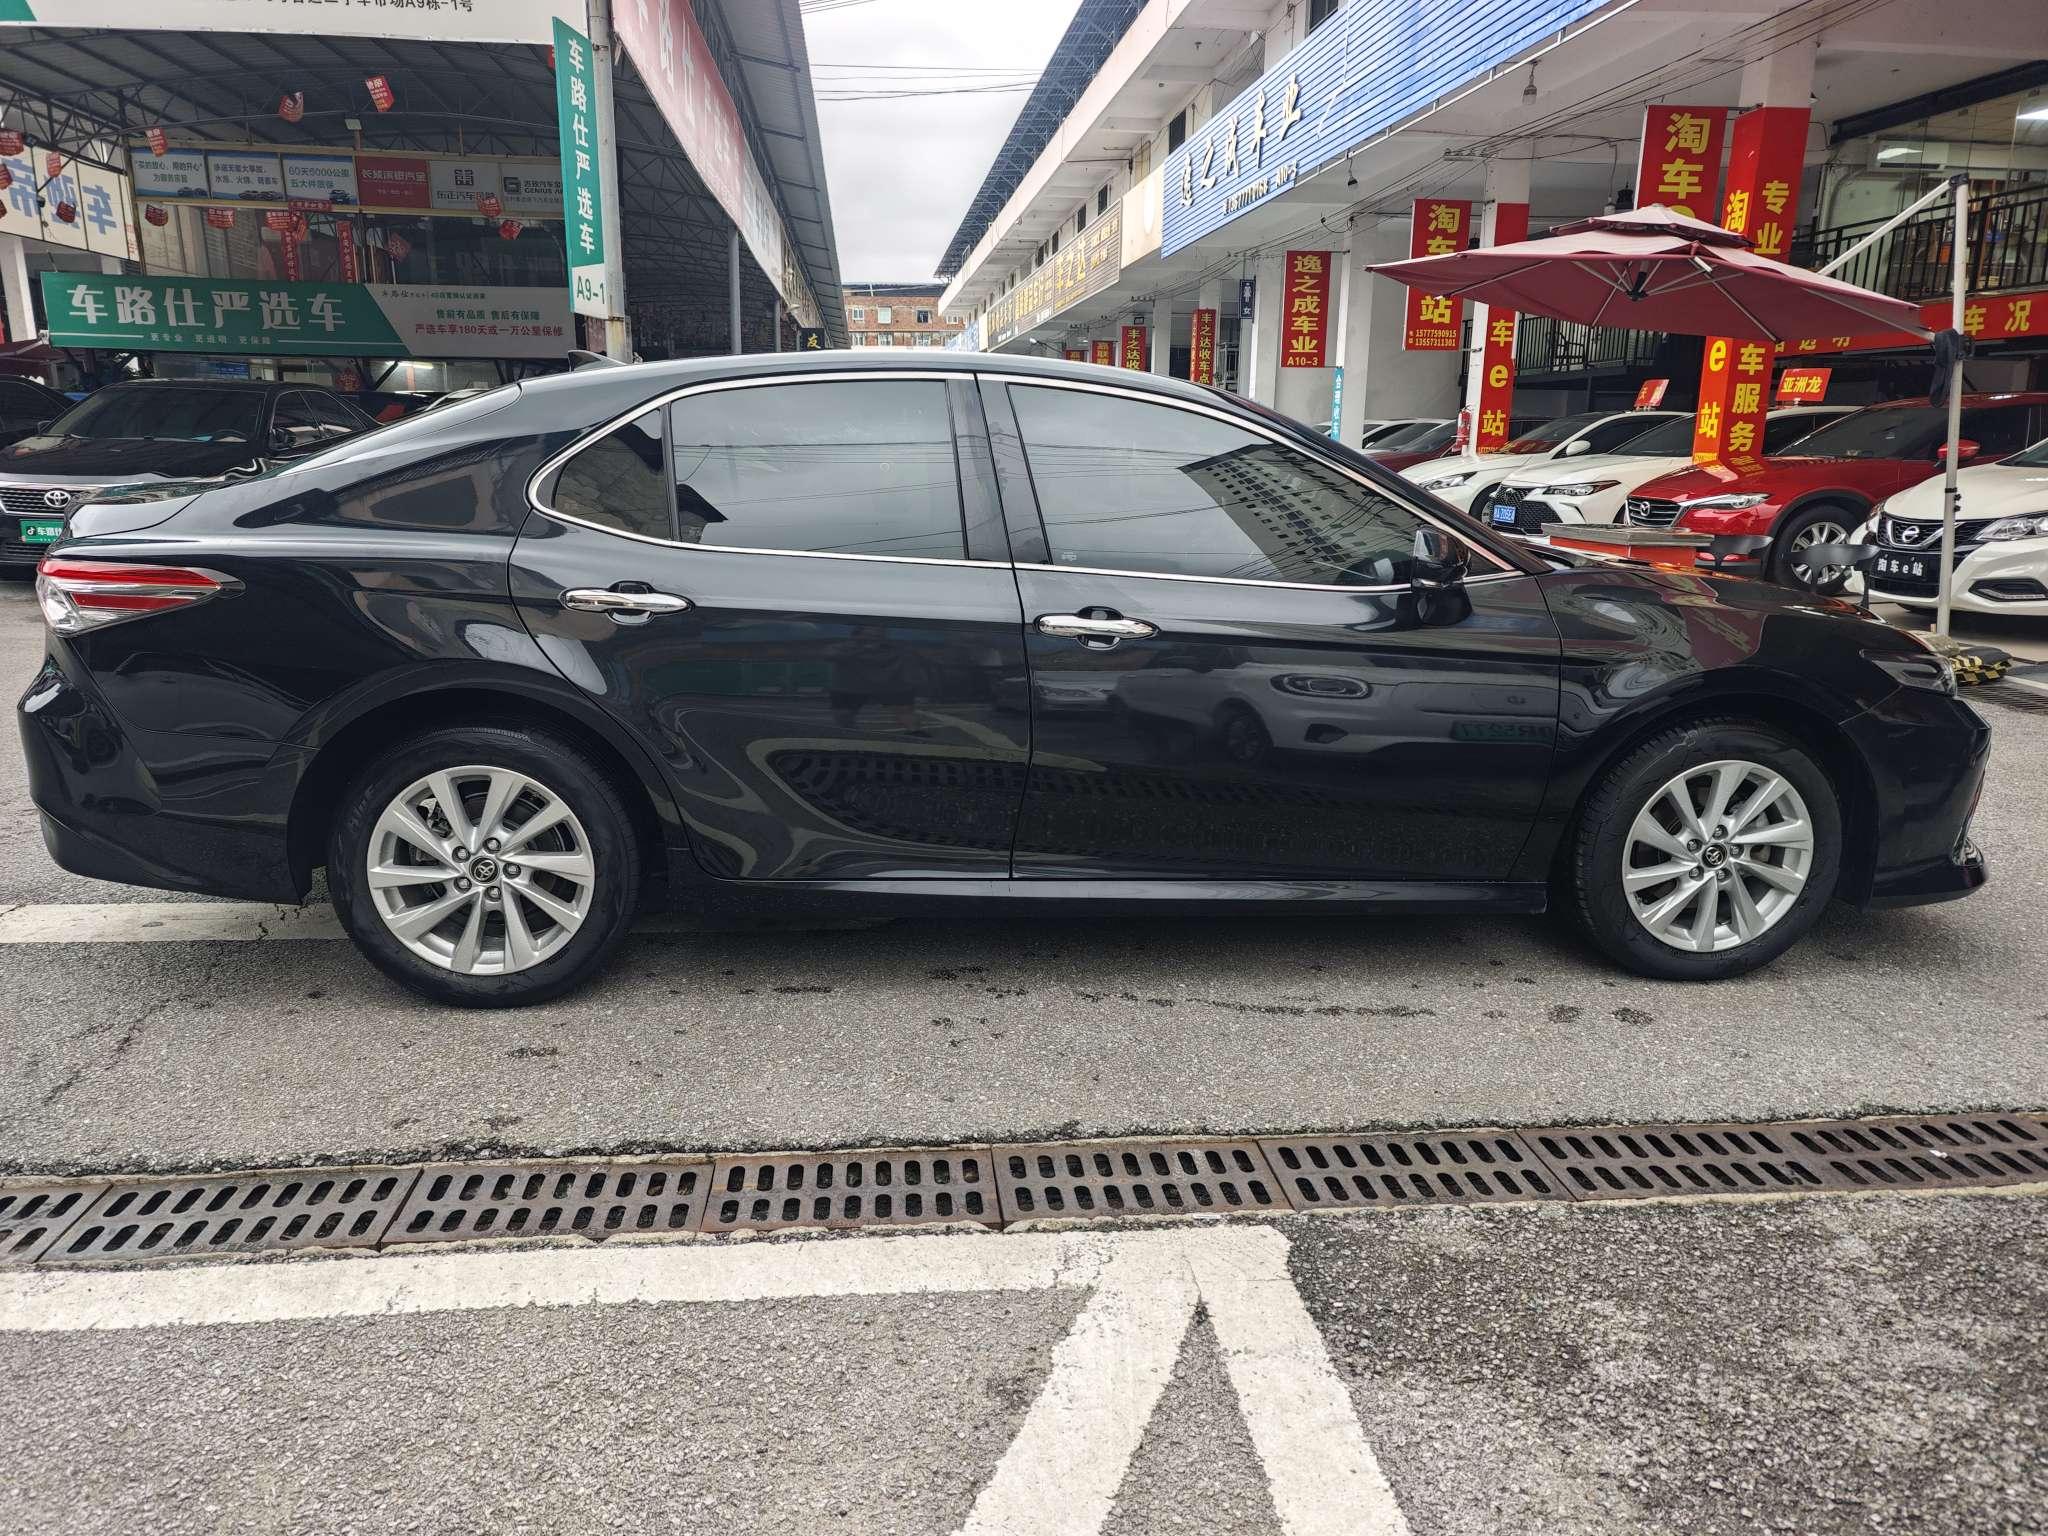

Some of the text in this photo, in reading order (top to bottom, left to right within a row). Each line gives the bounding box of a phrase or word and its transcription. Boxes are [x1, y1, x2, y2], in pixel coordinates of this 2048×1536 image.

[568, 37, 595, 255] 车路仕严选车
[576, 275, 606, 305] A9-1
[67, 284, 346, 332] 车路仕严选车
[1243, 307, 1251, 315] 女
[1289, 255, 1322, 353] 逸之成车业
[1287, 356, 1319, 366] A10-3
[1781, 375, 1823, 393] 亚洲龙
[1877, 558, 1924, 577] 淘车e站
